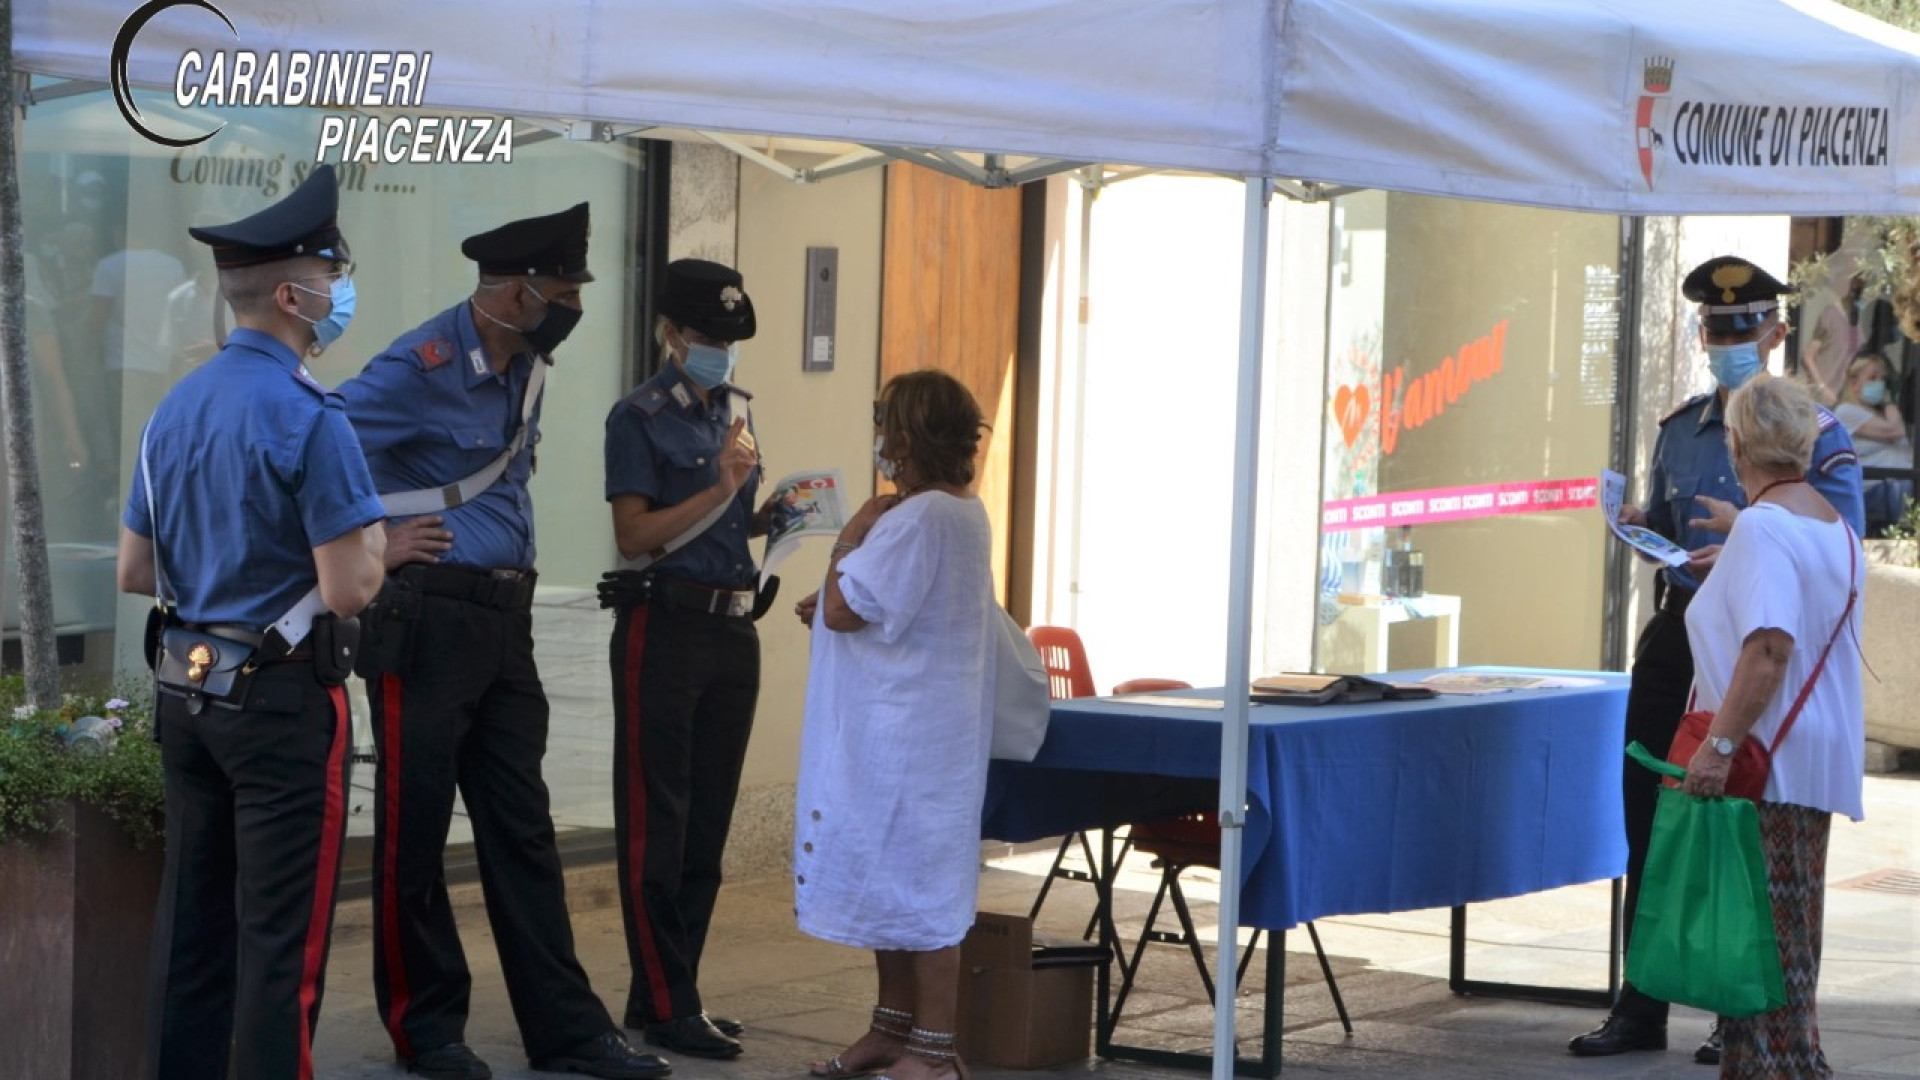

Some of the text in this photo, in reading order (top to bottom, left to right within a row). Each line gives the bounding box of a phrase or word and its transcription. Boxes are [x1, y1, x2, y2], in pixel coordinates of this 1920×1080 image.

[1673, 101, 1888, 166] COMUNE DI PIACENZA
[170, 146, 285, 197] Coming
[1352, 503, 1386, 521] SCONTI
[1391, 499, 1424, 517] SCONTI
[1428, 496, 1461, 513] SCONTI
[1462, 493, 1494, 510] SCONTI
[1498, 490, 1528, 506] SCONTI
